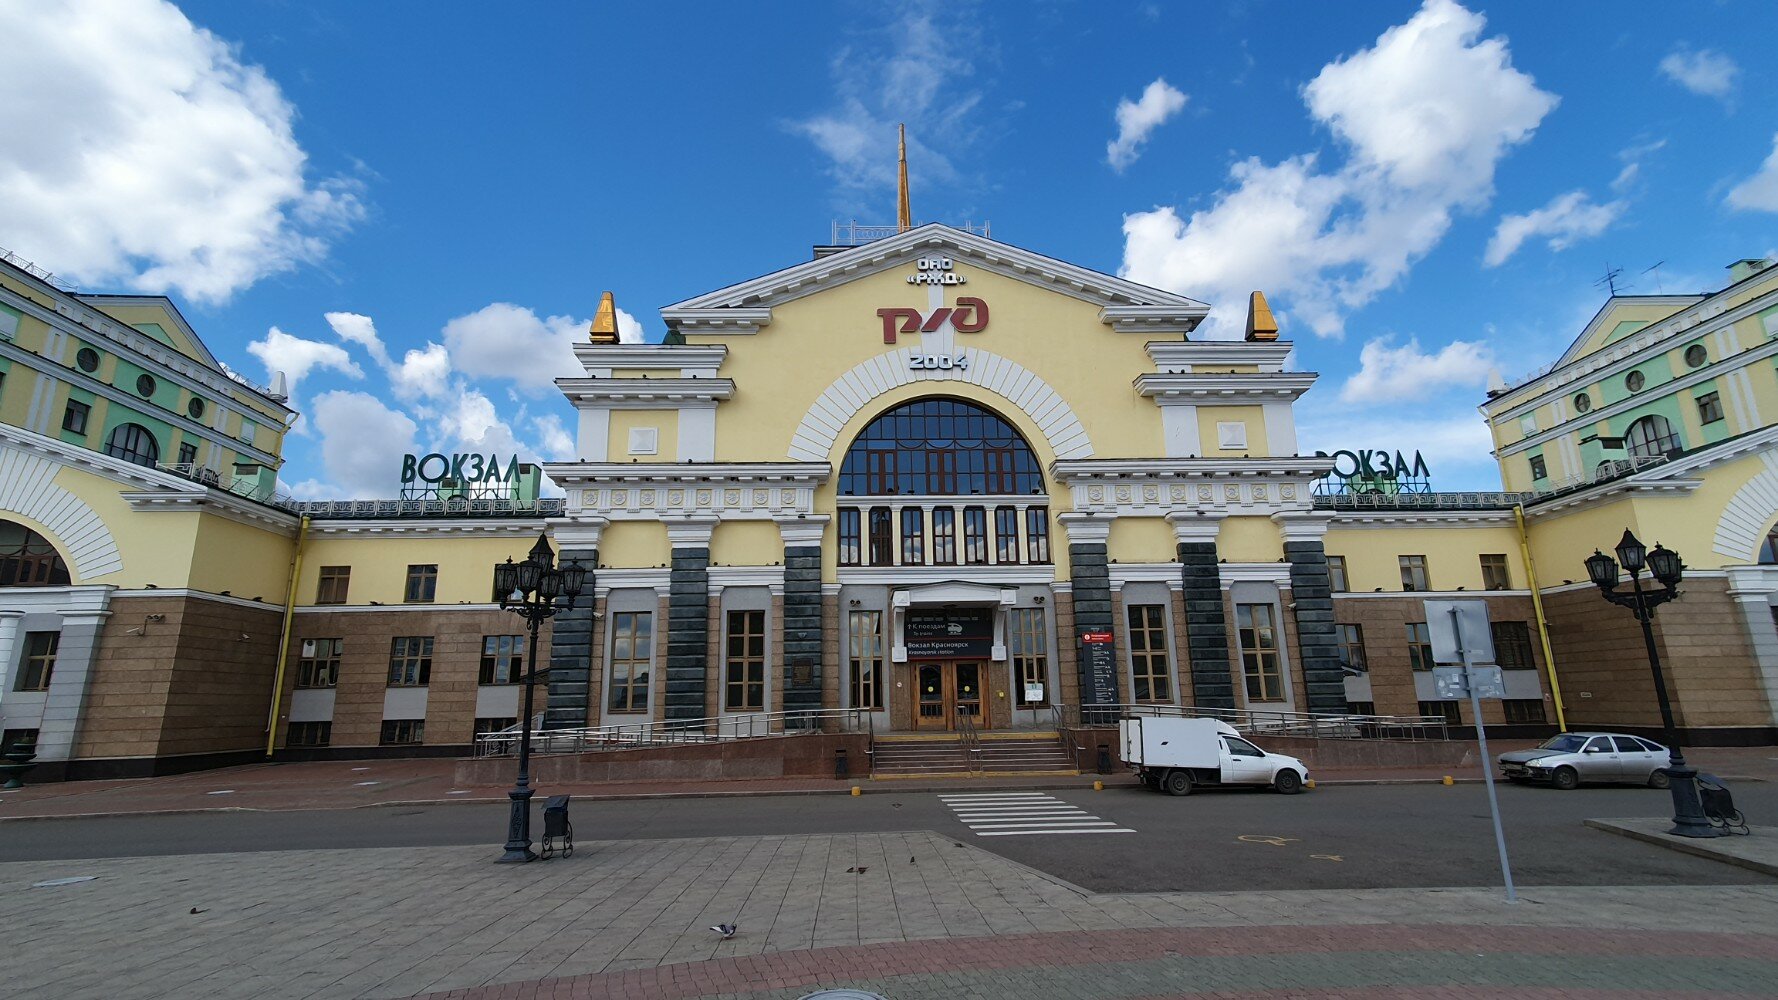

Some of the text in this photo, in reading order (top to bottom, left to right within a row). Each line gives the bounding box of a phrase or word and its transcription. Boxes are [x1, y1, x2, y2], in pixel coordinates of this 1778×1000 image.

[917, 258, 954, 271] ОАО
[909, 354, 968, 370] 2004
[400, 453, 521, 483] ВОКЗАЛ
